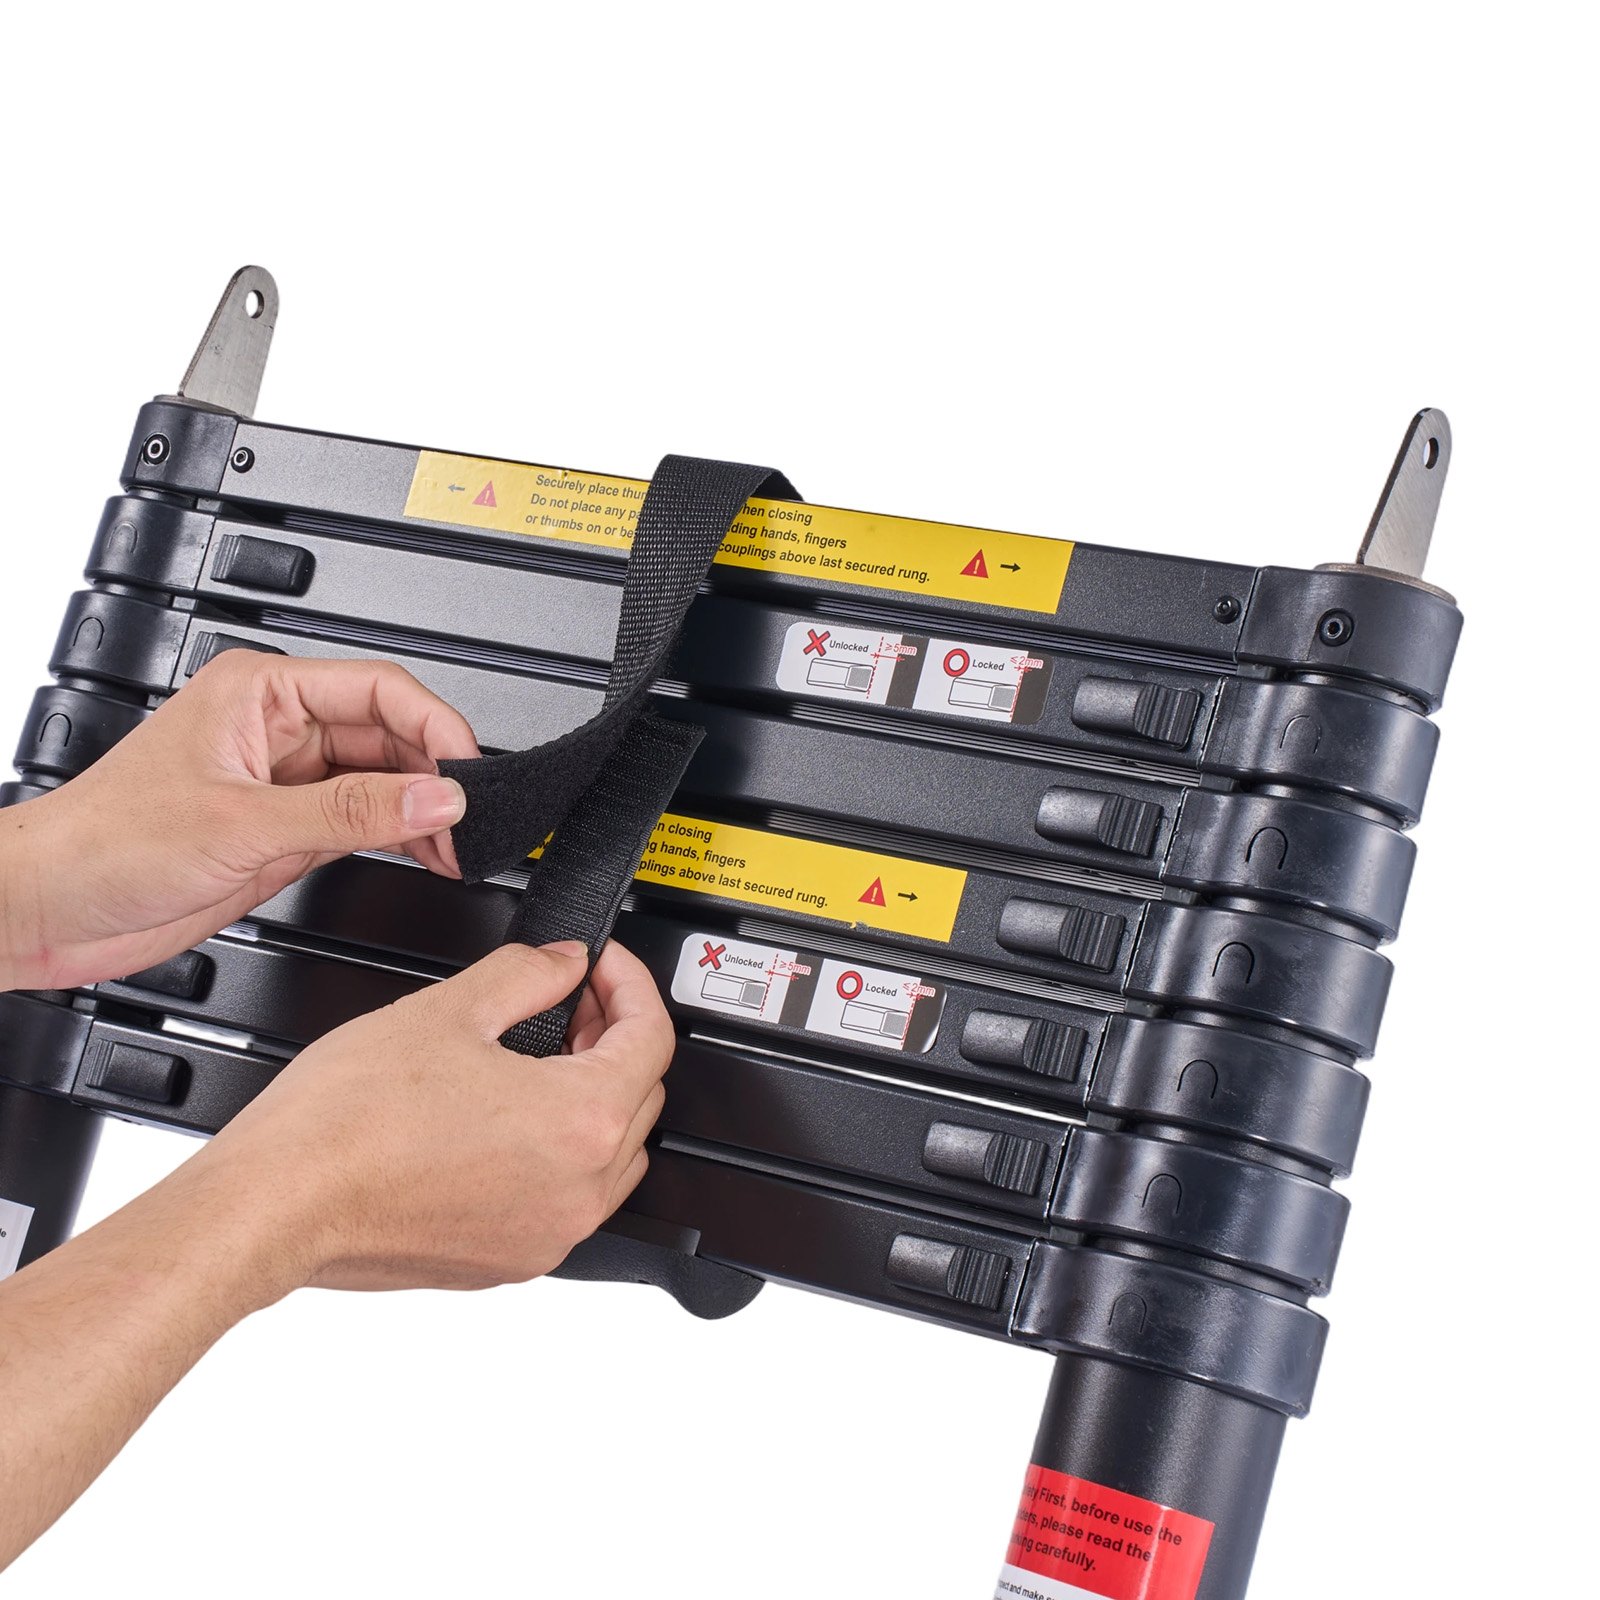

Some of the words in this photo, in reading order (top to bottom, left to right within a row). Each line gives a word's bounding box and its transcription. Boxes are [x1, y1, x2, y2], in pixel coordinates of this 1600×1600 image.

[536, 474, 585, 494] Securely
[587, 483, 619, 496] place
[740, 503, 765, 516] hen
[768, 508, 813, 526] closing
[531, 493, 547, 505] Do
[549, 498, 569, 509] not
[570, 500, 602, 515] place
[605, 506, 626, 519] any
[727, 523, 758, 539] ding
[760, 526, 800, 544] hands,
[804, 532, 847, 549] fingers
[525, 515, 538, 524] or
[540, 515, 583, 531] thumbs
[586, 523, 601, 533] on
[604, 526, 617, 536] or
[620, 526, 634, 539] be
[780, 550, 816, 565] above
[819, 554, 842, 568] last
[844, 560, 896, 577] secured
[897, 568, 930, 584] rung.
[829, 639, 869, 653] Unlocked
[972, 659, 1005, 671] Locked
[668, 823, 713, 843] closing
[660, 841, 700, 861] hands,
[703, 850, 746, 868] fingers
[638, 859, 676, 877] plings
[678, 867, 716, 883] above
[718, 874, 741, 889] last
[743, 881, 795, 899] secured
[796, 891, 828, 908] rung.
[724, 953, 764, 969] Unlocked
[865, 983, 898, 997] Locked
[1040, 1487, 1067, 1510] First,
[1071, 1497, 1120, 1525] before
[1123, 1517, 1153, 1535] use
[1158, 1526, 1182, 1545] the
[1040, 1515, 1084, 1539] please
[1086, 1531, 1124, 1552] read
[1126, 1543, 1152, 1562] the
[1035, 1541, 1096, 1572] carefully.
[1009, 1584, 1022, 1595] and
[1022, 1588, 1044, 1600] make
